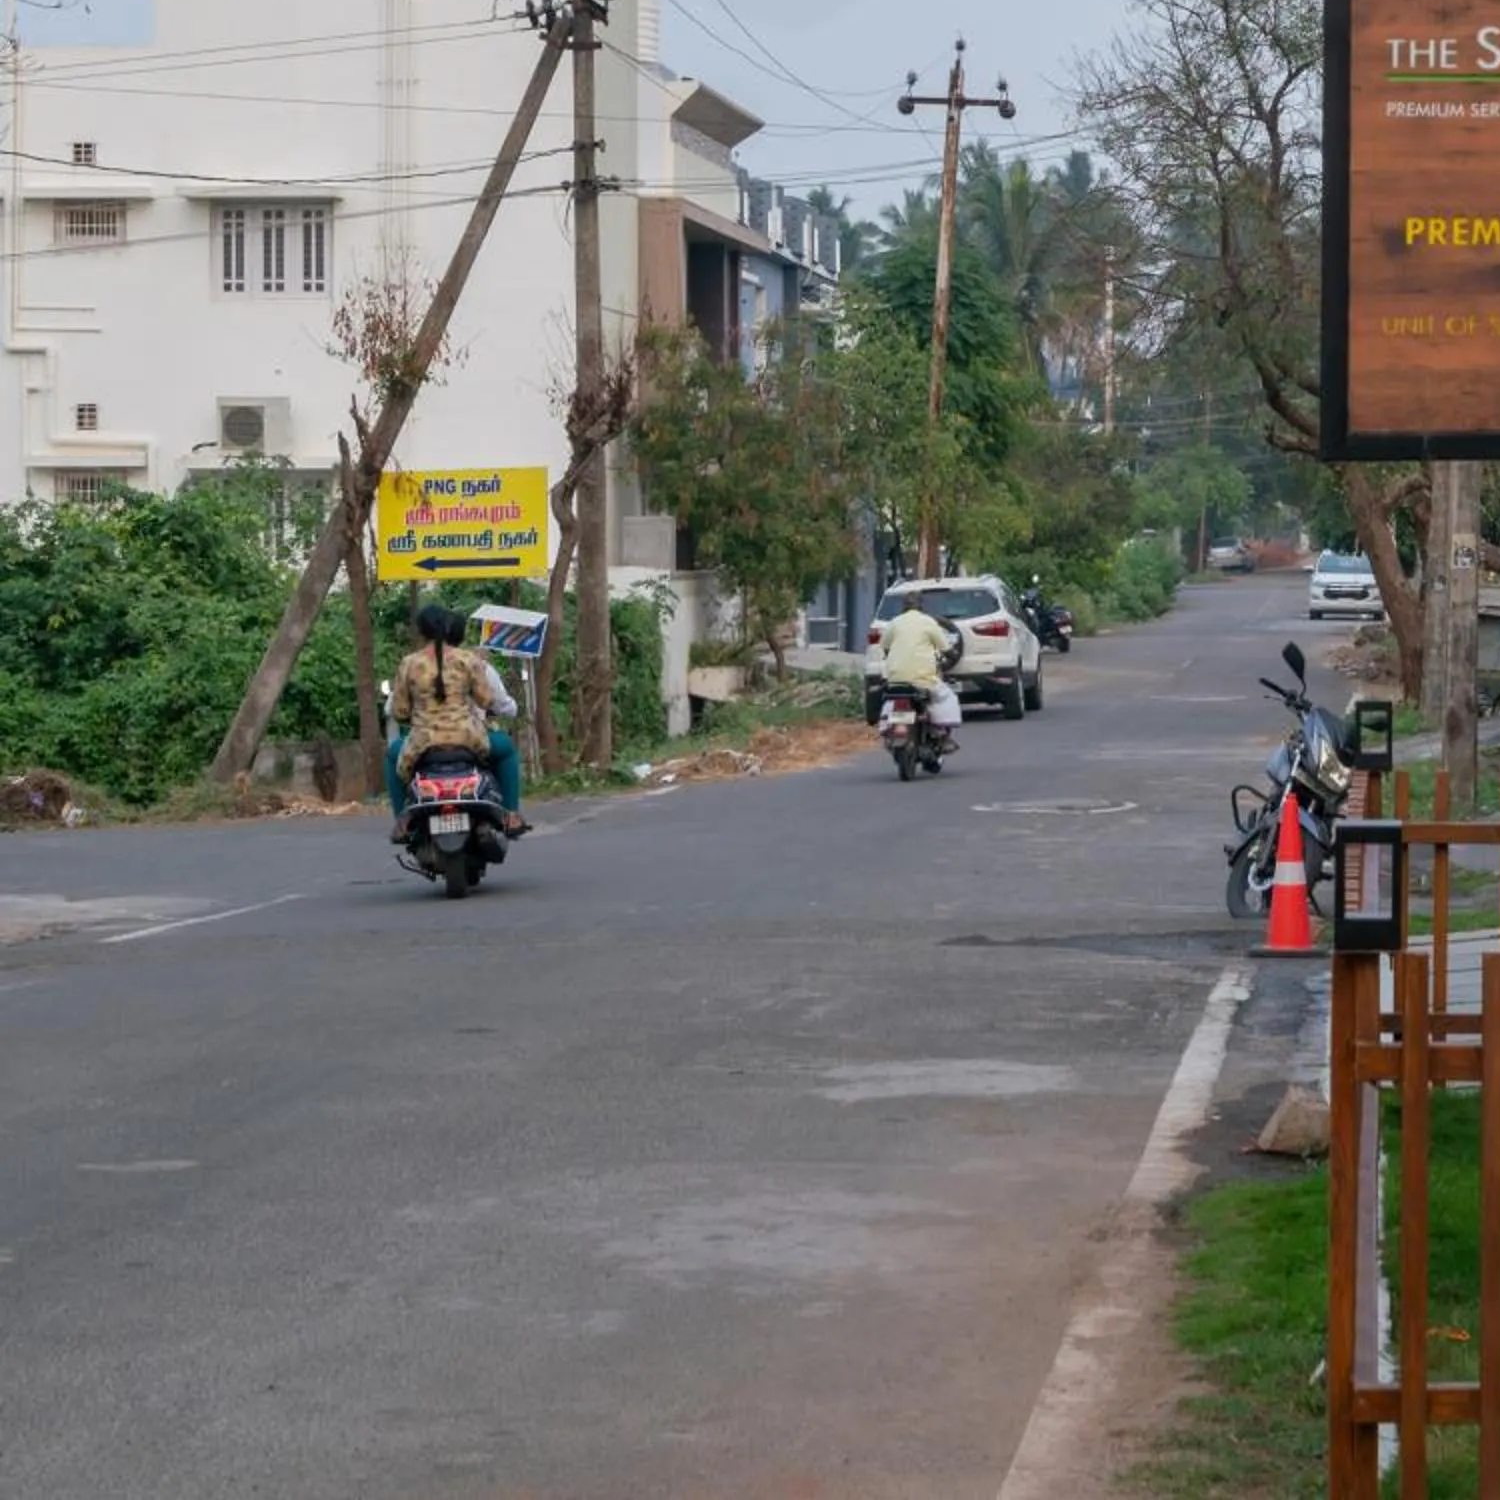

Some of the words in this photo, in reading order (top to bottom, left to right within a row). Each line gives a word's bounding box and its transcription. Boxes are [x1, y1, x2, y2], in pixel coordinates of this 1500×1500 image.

[1385, 38, 1457, 69] THE
[1386, 102, 1464, 118] PREMIUM
[1381, 315, 1435, 336] UNIT
[1445, 315, 1478, 336] OF
[423, 479, 457, 495] PNG
[461, 474, 501, 497] நகர்
[498, 526, 538, 550] நகர்
